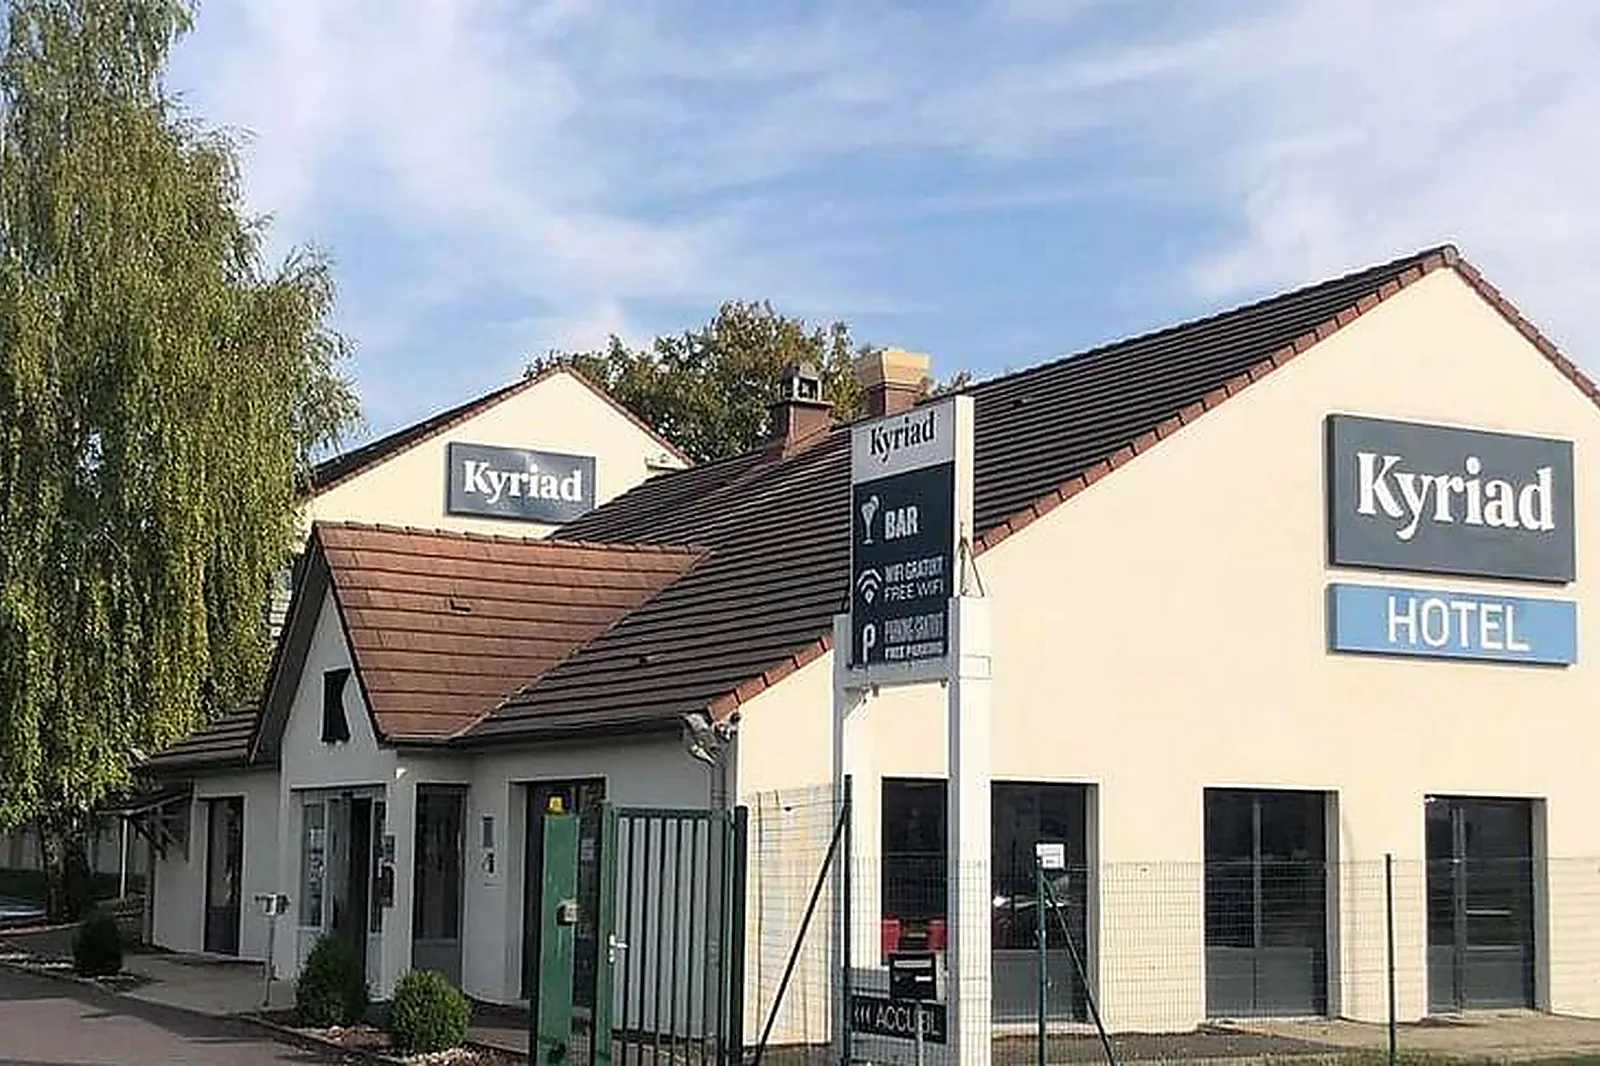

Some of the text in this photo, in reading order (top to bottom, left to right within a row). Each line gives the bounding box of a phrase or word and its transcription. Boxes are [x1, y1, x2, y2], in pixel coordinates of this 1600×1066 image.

[870, 410, 935, 462] Kyriad
[463, 459, 583, 504] Kyriad
[1356, 451, 1555, 540] Kyriad
[885, 505, 919, 541] BAR
[884, 582, 915, 602] FREE
[1387, 596, 1530, 652] HOTEL
